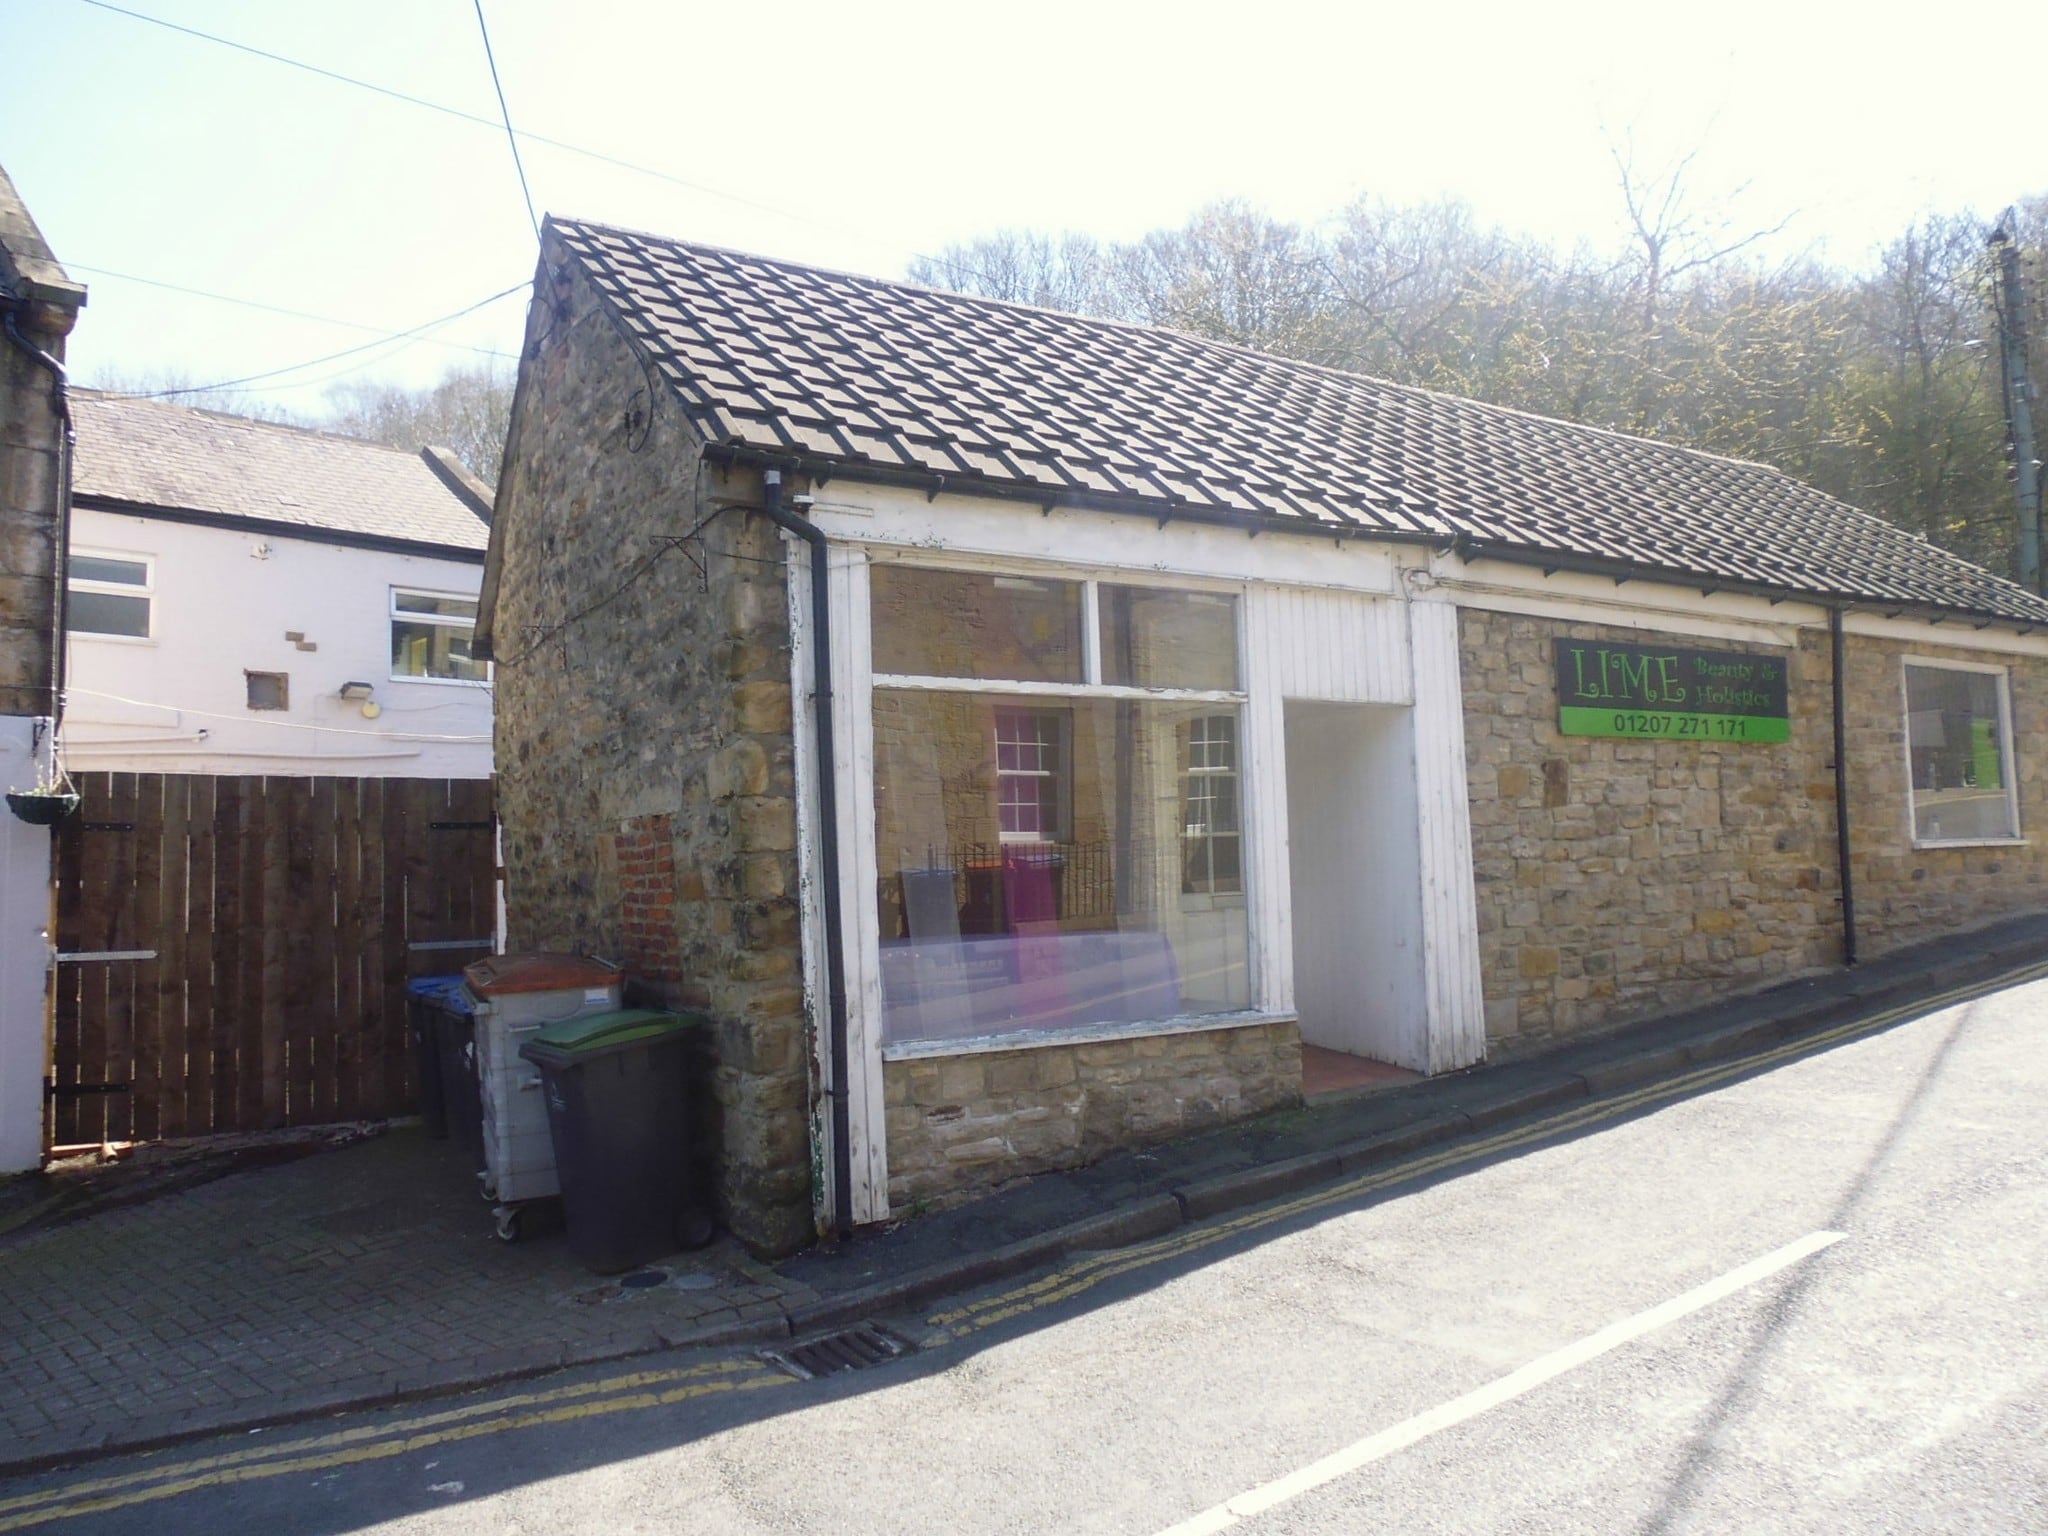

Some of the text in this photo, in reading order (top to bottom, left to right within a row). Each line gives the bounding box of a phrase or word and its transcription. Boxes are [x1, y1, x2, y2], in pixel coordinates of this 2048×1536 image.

[1570, 649, 1687, 703] LIME
[1695, 656, 1778, 680] Beauty &
[1695, 685, 1770, 707] Holistics
[1614, 714, 1746, 737] 01207 271 171
